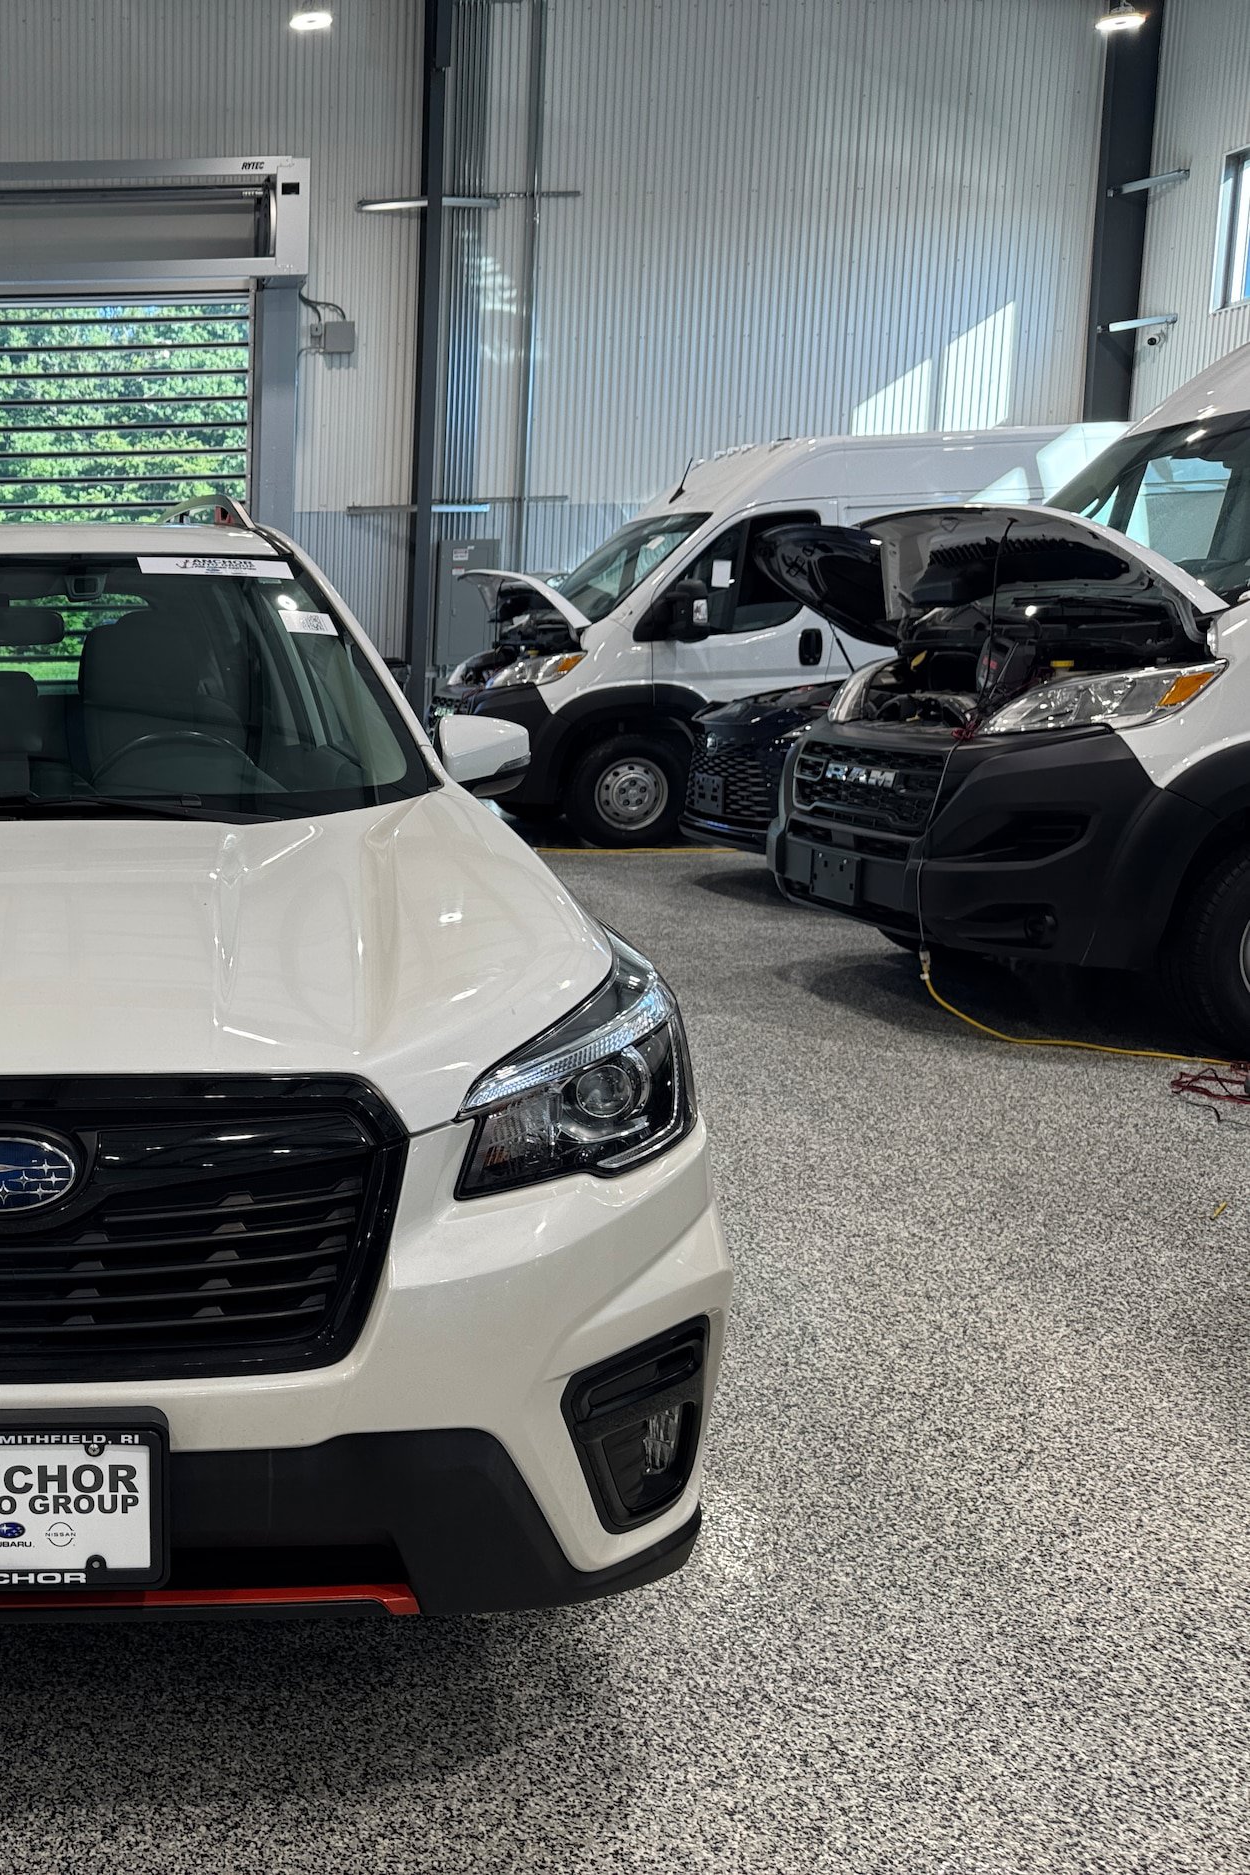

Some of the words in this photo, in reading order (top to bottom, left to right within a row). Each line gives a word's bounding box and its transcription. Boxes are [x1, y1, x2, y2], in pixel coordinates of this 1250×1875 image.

[241, 161, 265, 170] RYTEC
[825, 762, 896, 788] RAM
[120, 1434, 140, 1444] RI
[28, 1494, 139, 1515] GROUP
